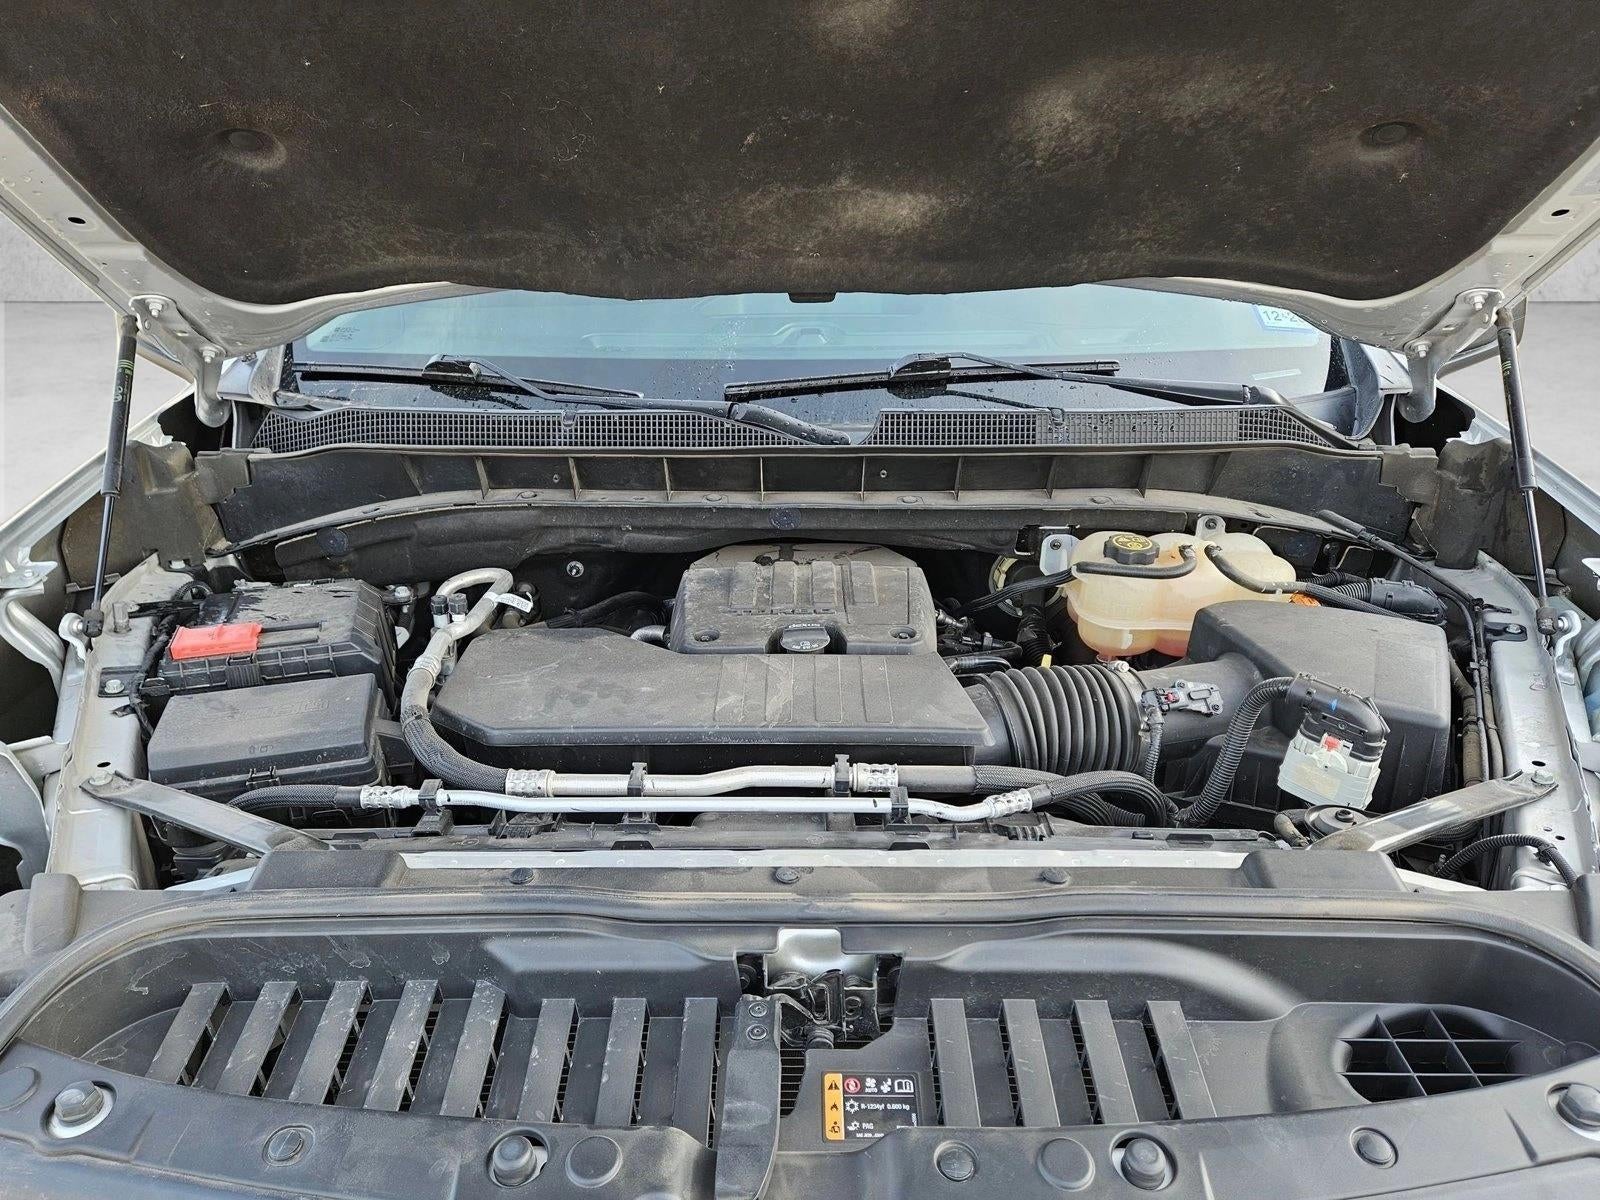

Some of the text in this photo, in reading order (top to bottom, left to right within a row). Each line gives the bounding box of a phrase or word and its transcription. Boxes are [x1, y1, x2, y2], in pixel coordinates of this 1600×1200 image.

[1263, 310, 1282, 321] 12
[902, 1103, 910, 1111] kg
[862, 1122, 874, 1130] PAG
